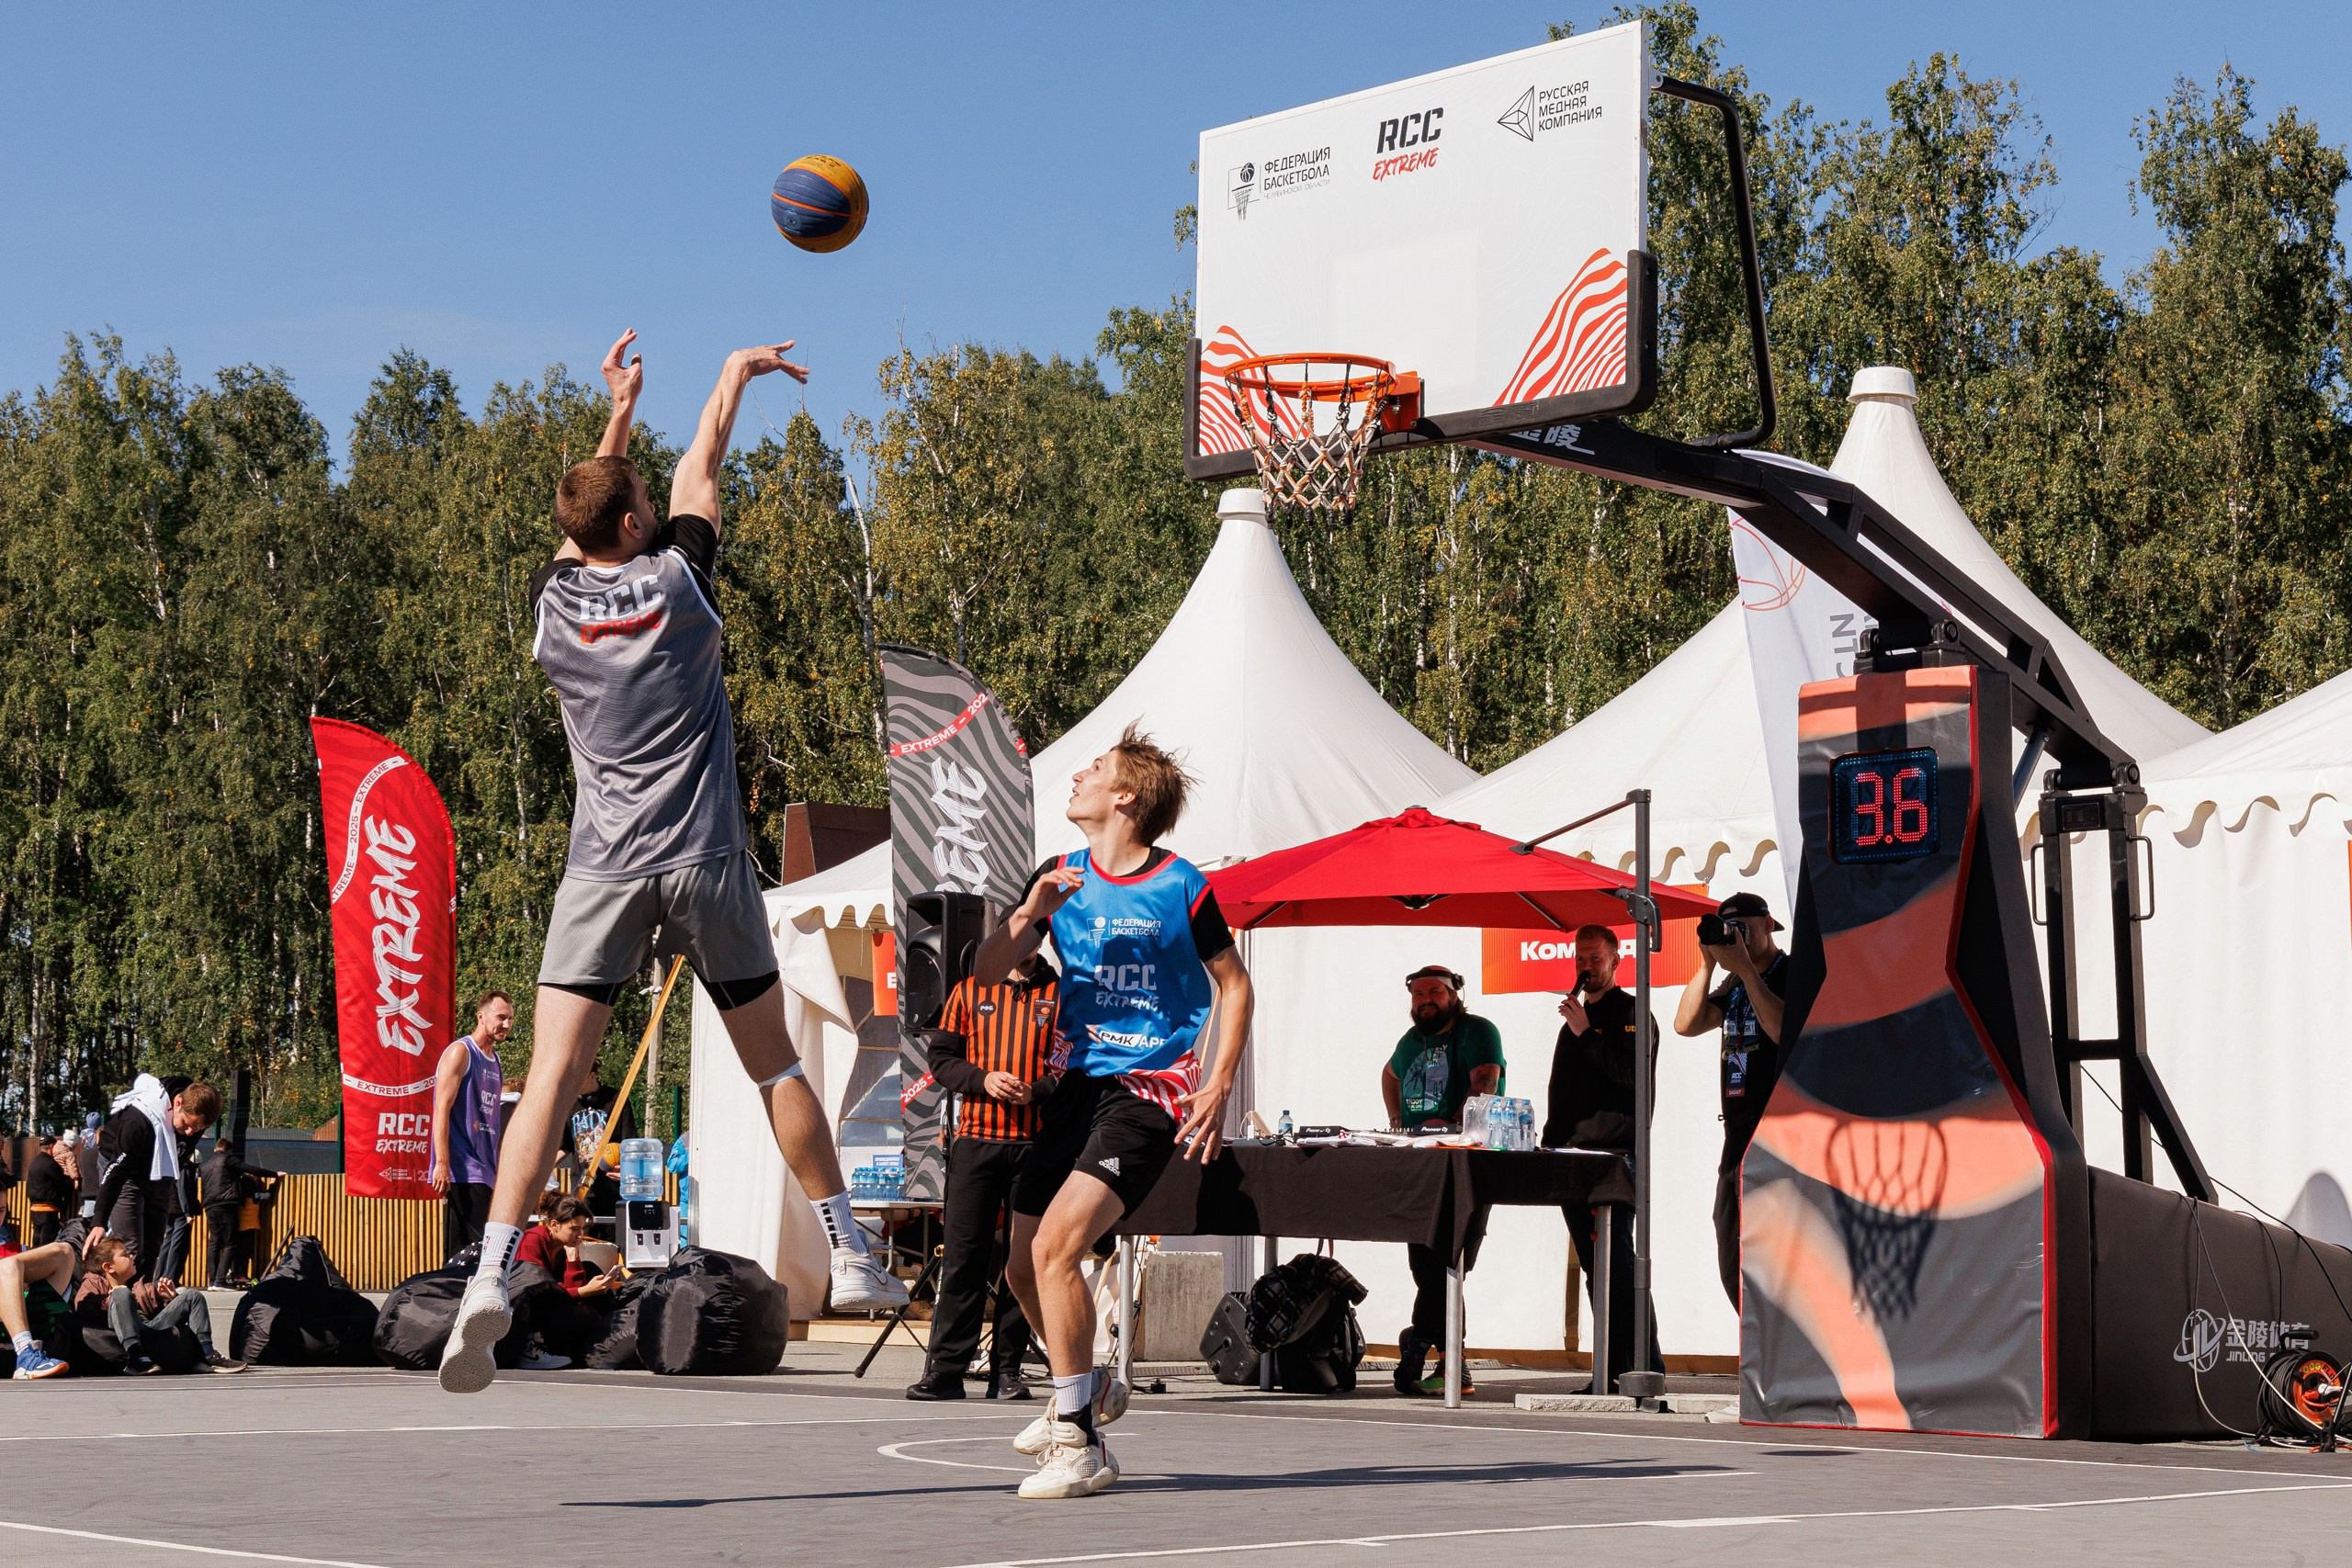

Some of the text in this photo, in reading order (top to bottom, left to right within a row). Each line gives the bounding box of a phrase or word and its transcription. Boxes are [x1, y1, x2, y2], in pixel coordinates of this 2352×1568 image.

[1539, 80, 1589, 103] РУССКАЯ
[1538, 106, 1602, 132] КОМПАНИЯ
[1539, 96, 1587, 118] МЕДНАЯ
[1376, 107, 1443, 154] RCC
[1264, 146, 1330, 175] ФЕДЕРАЦИЯ
[1373, 147, 1440, 183] EXTREME
[1263, 164, 1330, 191] БАСКЕТБОЛА
[578, 574, 662, 621] RCC
[578, 609, 664, 645] EXTREME
[967, 693, 989, 716] 202
[900, 723, 958, 754] EXTREME
[350, 815, 360, 844] 2025
[355, 762, 390, 804] EXTREME
[1855, 766, 1928, 847] 3.6
[930, 755, 989, 895] EME
[364, 814, 434, 1056] EXTREME
[1112, 918, 1161, 929] ФЕДЕРАЦИЯ
[1112, 928, 1159, 937] БАСКЕТБОЛА
[1093, 964, 1158, 991] RCC
[1095, 991, 1160, 1012] EXTREME
[356, 1080, 410, 1096] EXTREME
[900, 1077, 928, 1103] 2025
[377, 1112, 431, 1136] RCC
[375, 1138, 428, 1155] EXTREME
[1098, 1159, 1121, 1177] adidas
[2225, 1350, 2266, 1363] JINLING
